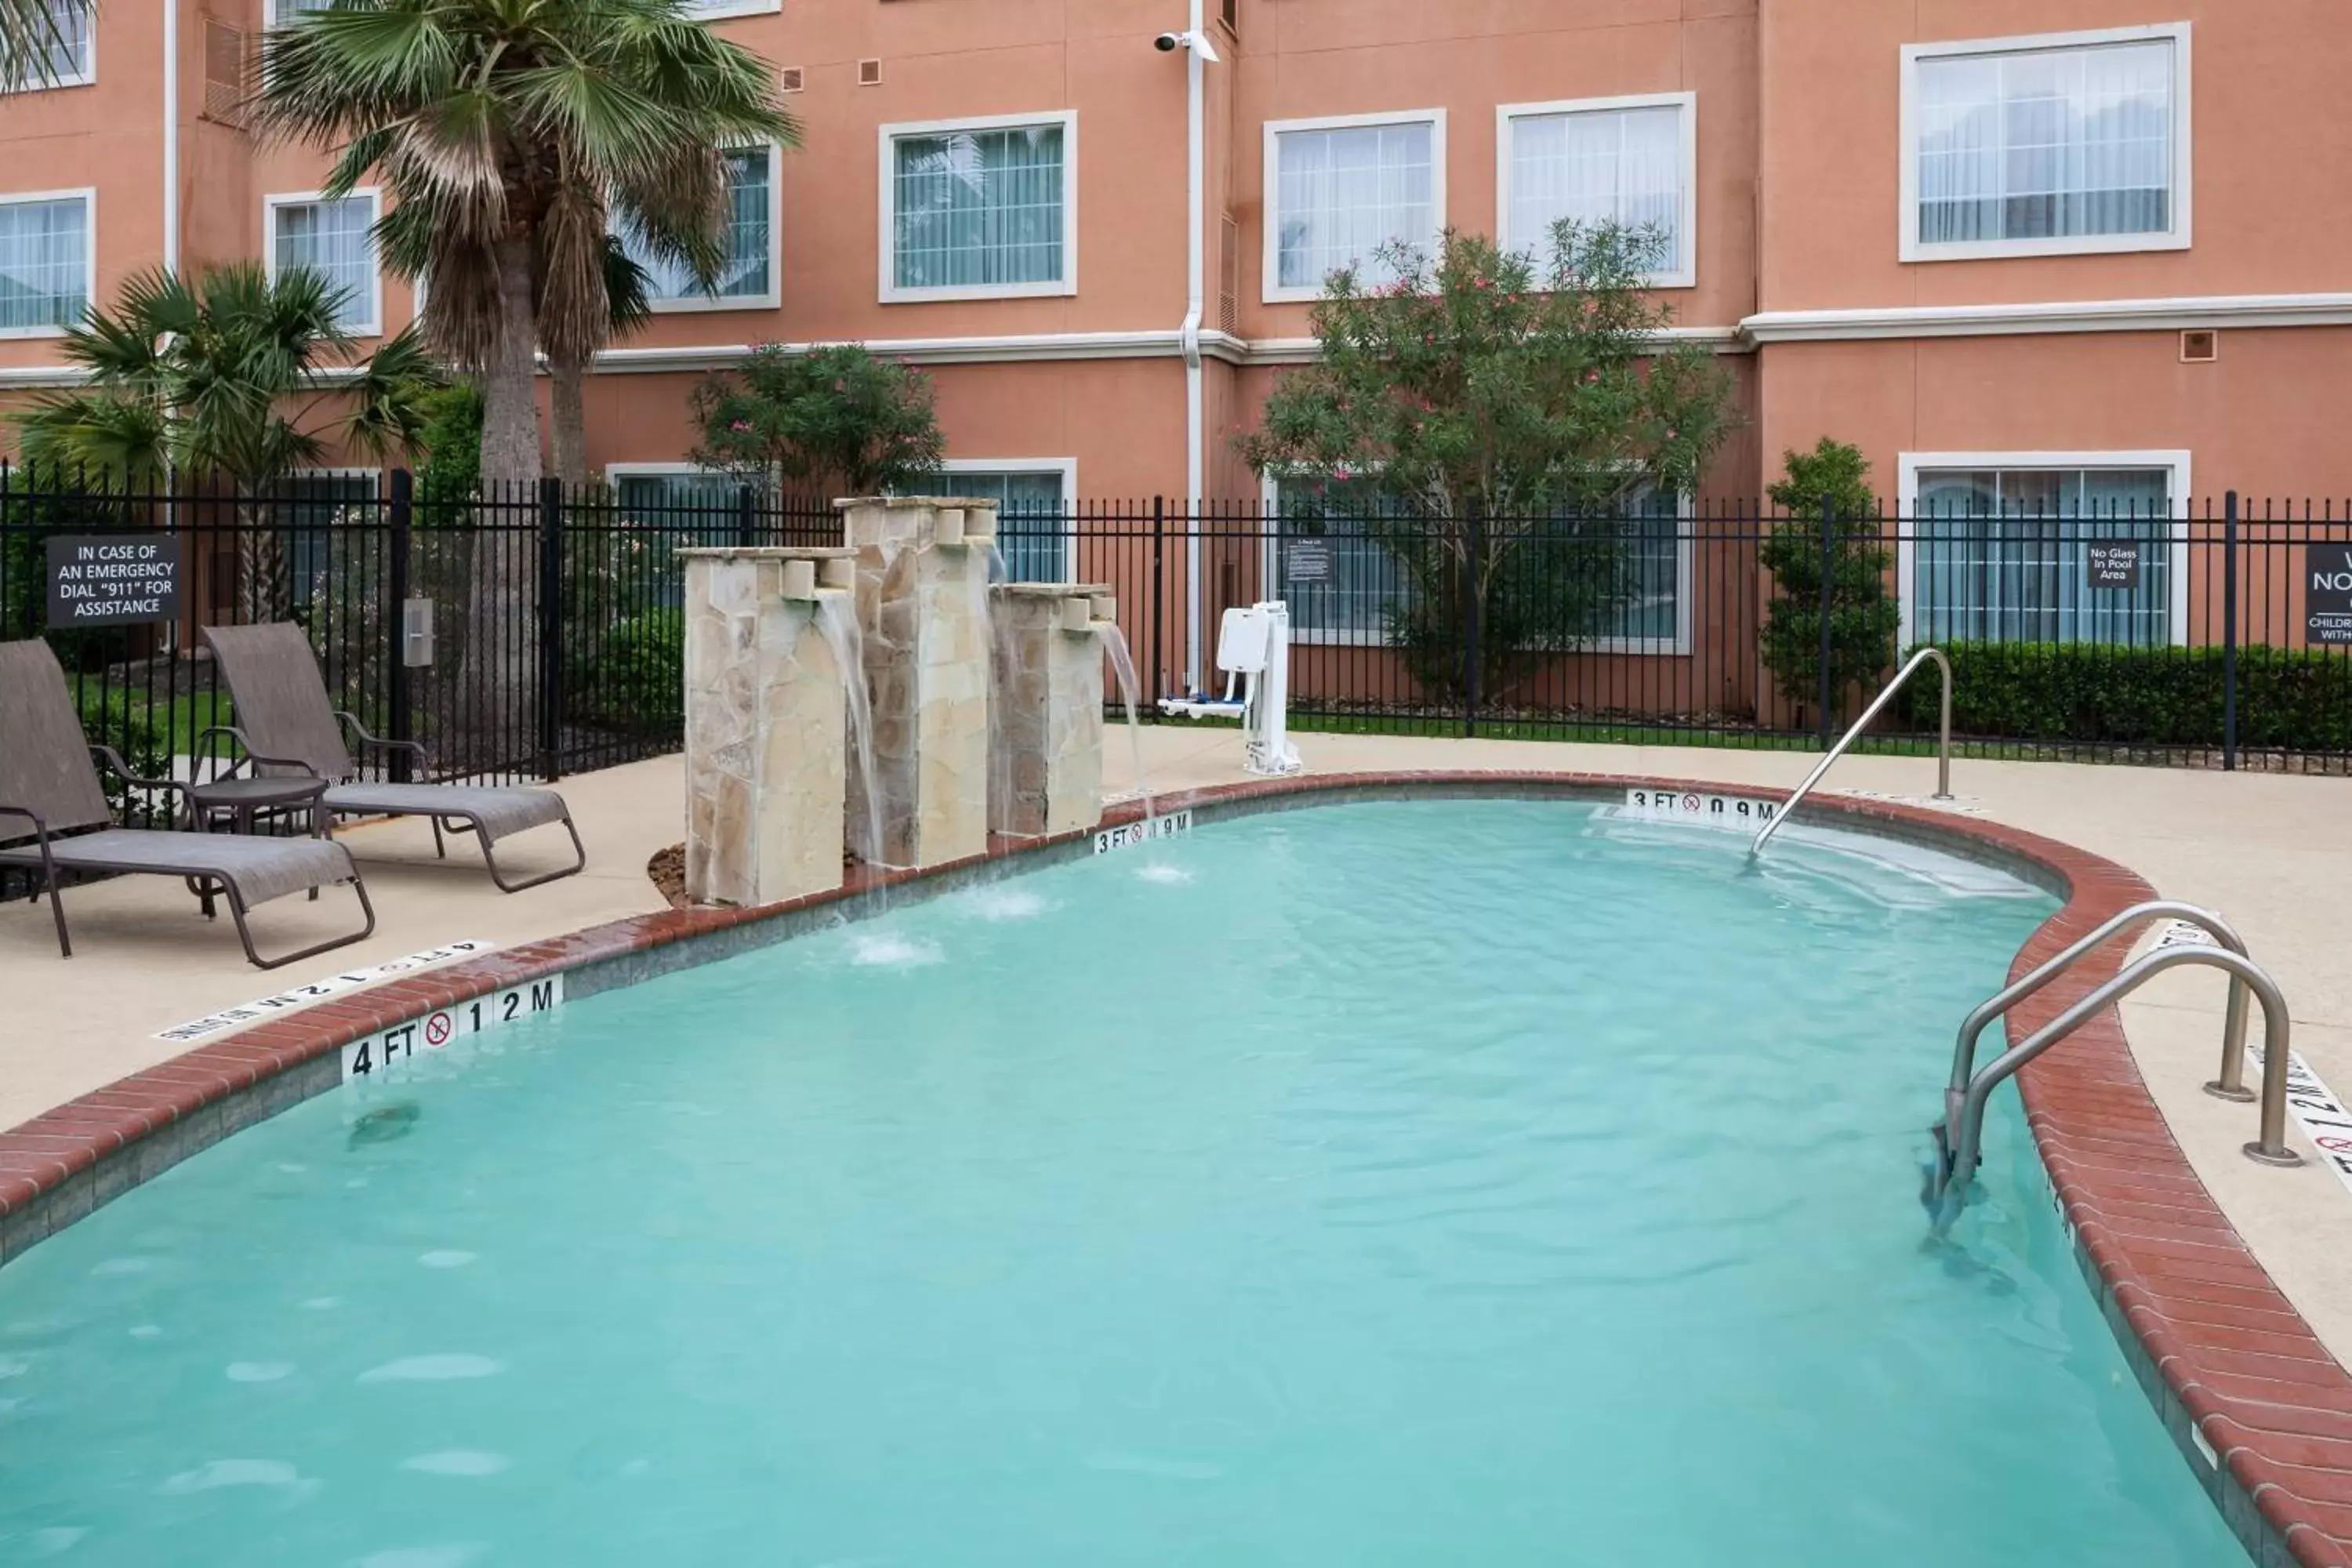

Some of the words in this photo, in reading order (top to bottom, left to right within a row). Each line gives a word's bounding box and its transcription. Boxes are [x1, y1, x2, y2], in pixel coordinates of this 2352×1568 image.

[78, 546, 93, 561] IN
[99, 545, 135, 561] CASE
[138, 545, 157, 559] OF
[2091, 548, 2107, 558] No
[2109, 548, 2136, 558] Glass
[58, 564, 82, 580] AN
[87, 562, 174, 579] EMERGENCY
[2094, 559, 2105, 568] In
[2108, 559, 2132, 568] Pool
[2100, 570, 2126, 579] Area
[2314, 572, 2352, 590] NO
[60, 583, 96, 599] DIAL
[145, 580, 172, 595] FOR
[74, 598, 160, 617] ASSISTANCE
[1634, 792, 1646, 807] 3
[1655, 793, 1677, 808] FT
[1758, 803, 1773, 819] M
[1099, 833, 1108, 854] 3
[1112, 828, 1127, 848] FT
[1164, 818, 1172, 835] 9
[1177, 814, 1186, 831] M
[352, 1041, 372, 1076] 4
[383, 1025, 416, 1065] FT
[470, 1002, 481, 1033] 1
[503, 992, 520, 1022] 2
[532, 980, 553, 1011] M
